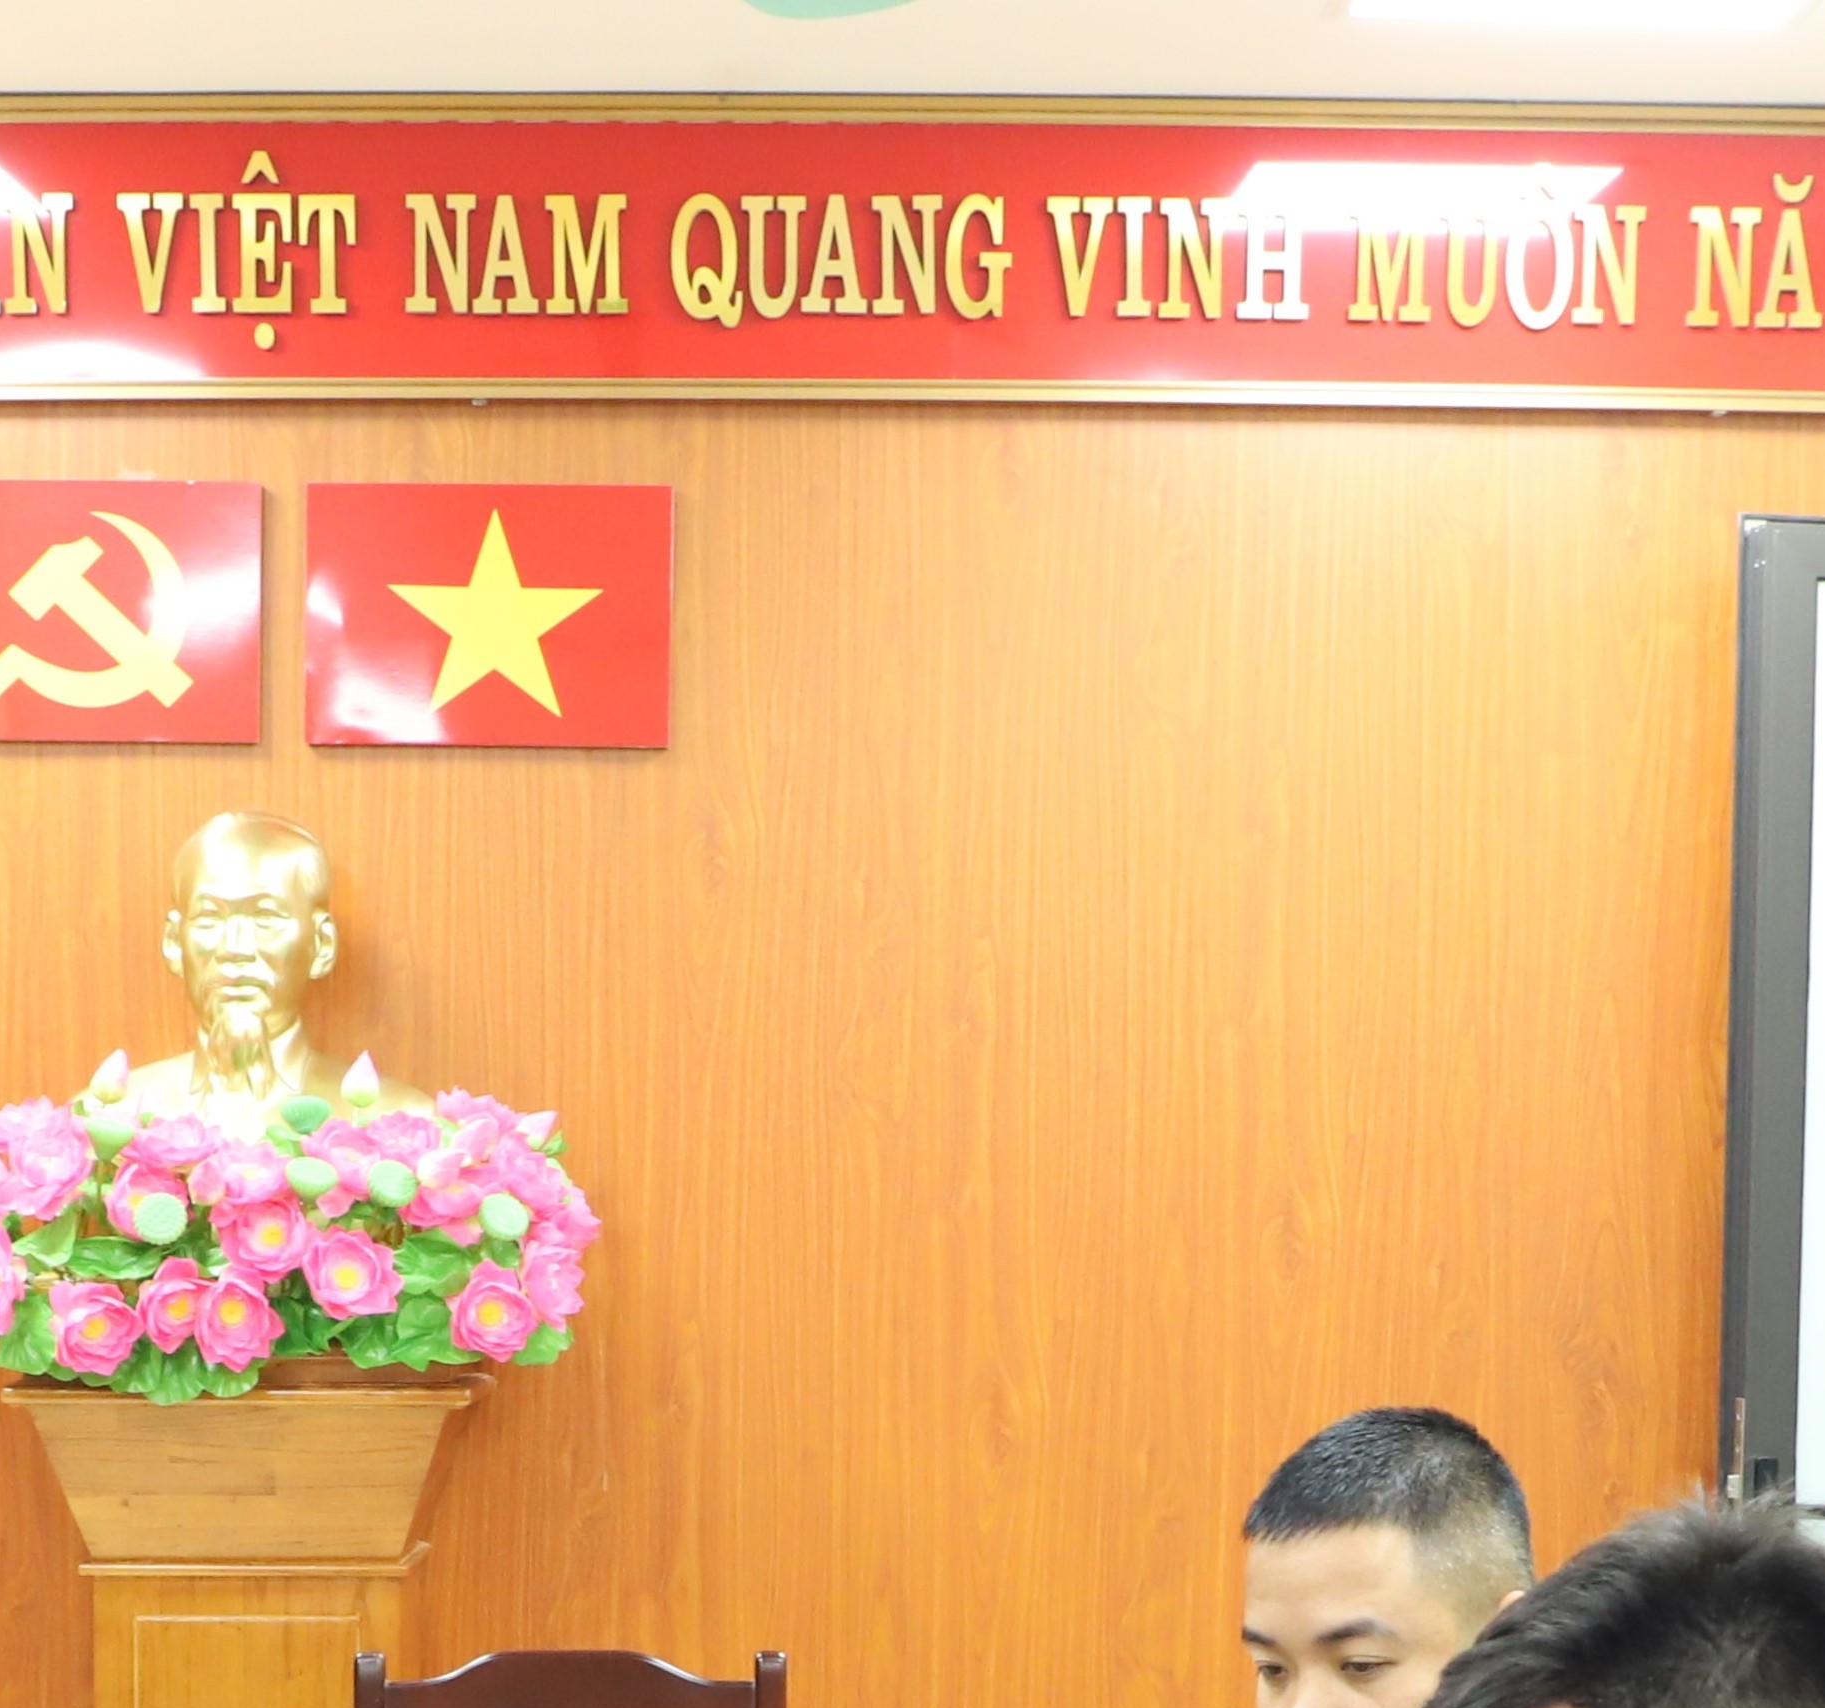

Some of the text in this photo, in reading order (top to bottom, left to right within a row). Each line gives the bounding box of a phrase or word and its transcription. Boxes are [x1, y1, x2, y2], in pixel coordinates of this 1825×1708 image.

[118, 150, 357, 350] VIỆT
[406, 192, 630, 317] NAM
[671, 191, 1013, 329] QUANG
[1047, 194, 1310, 322] VINH
